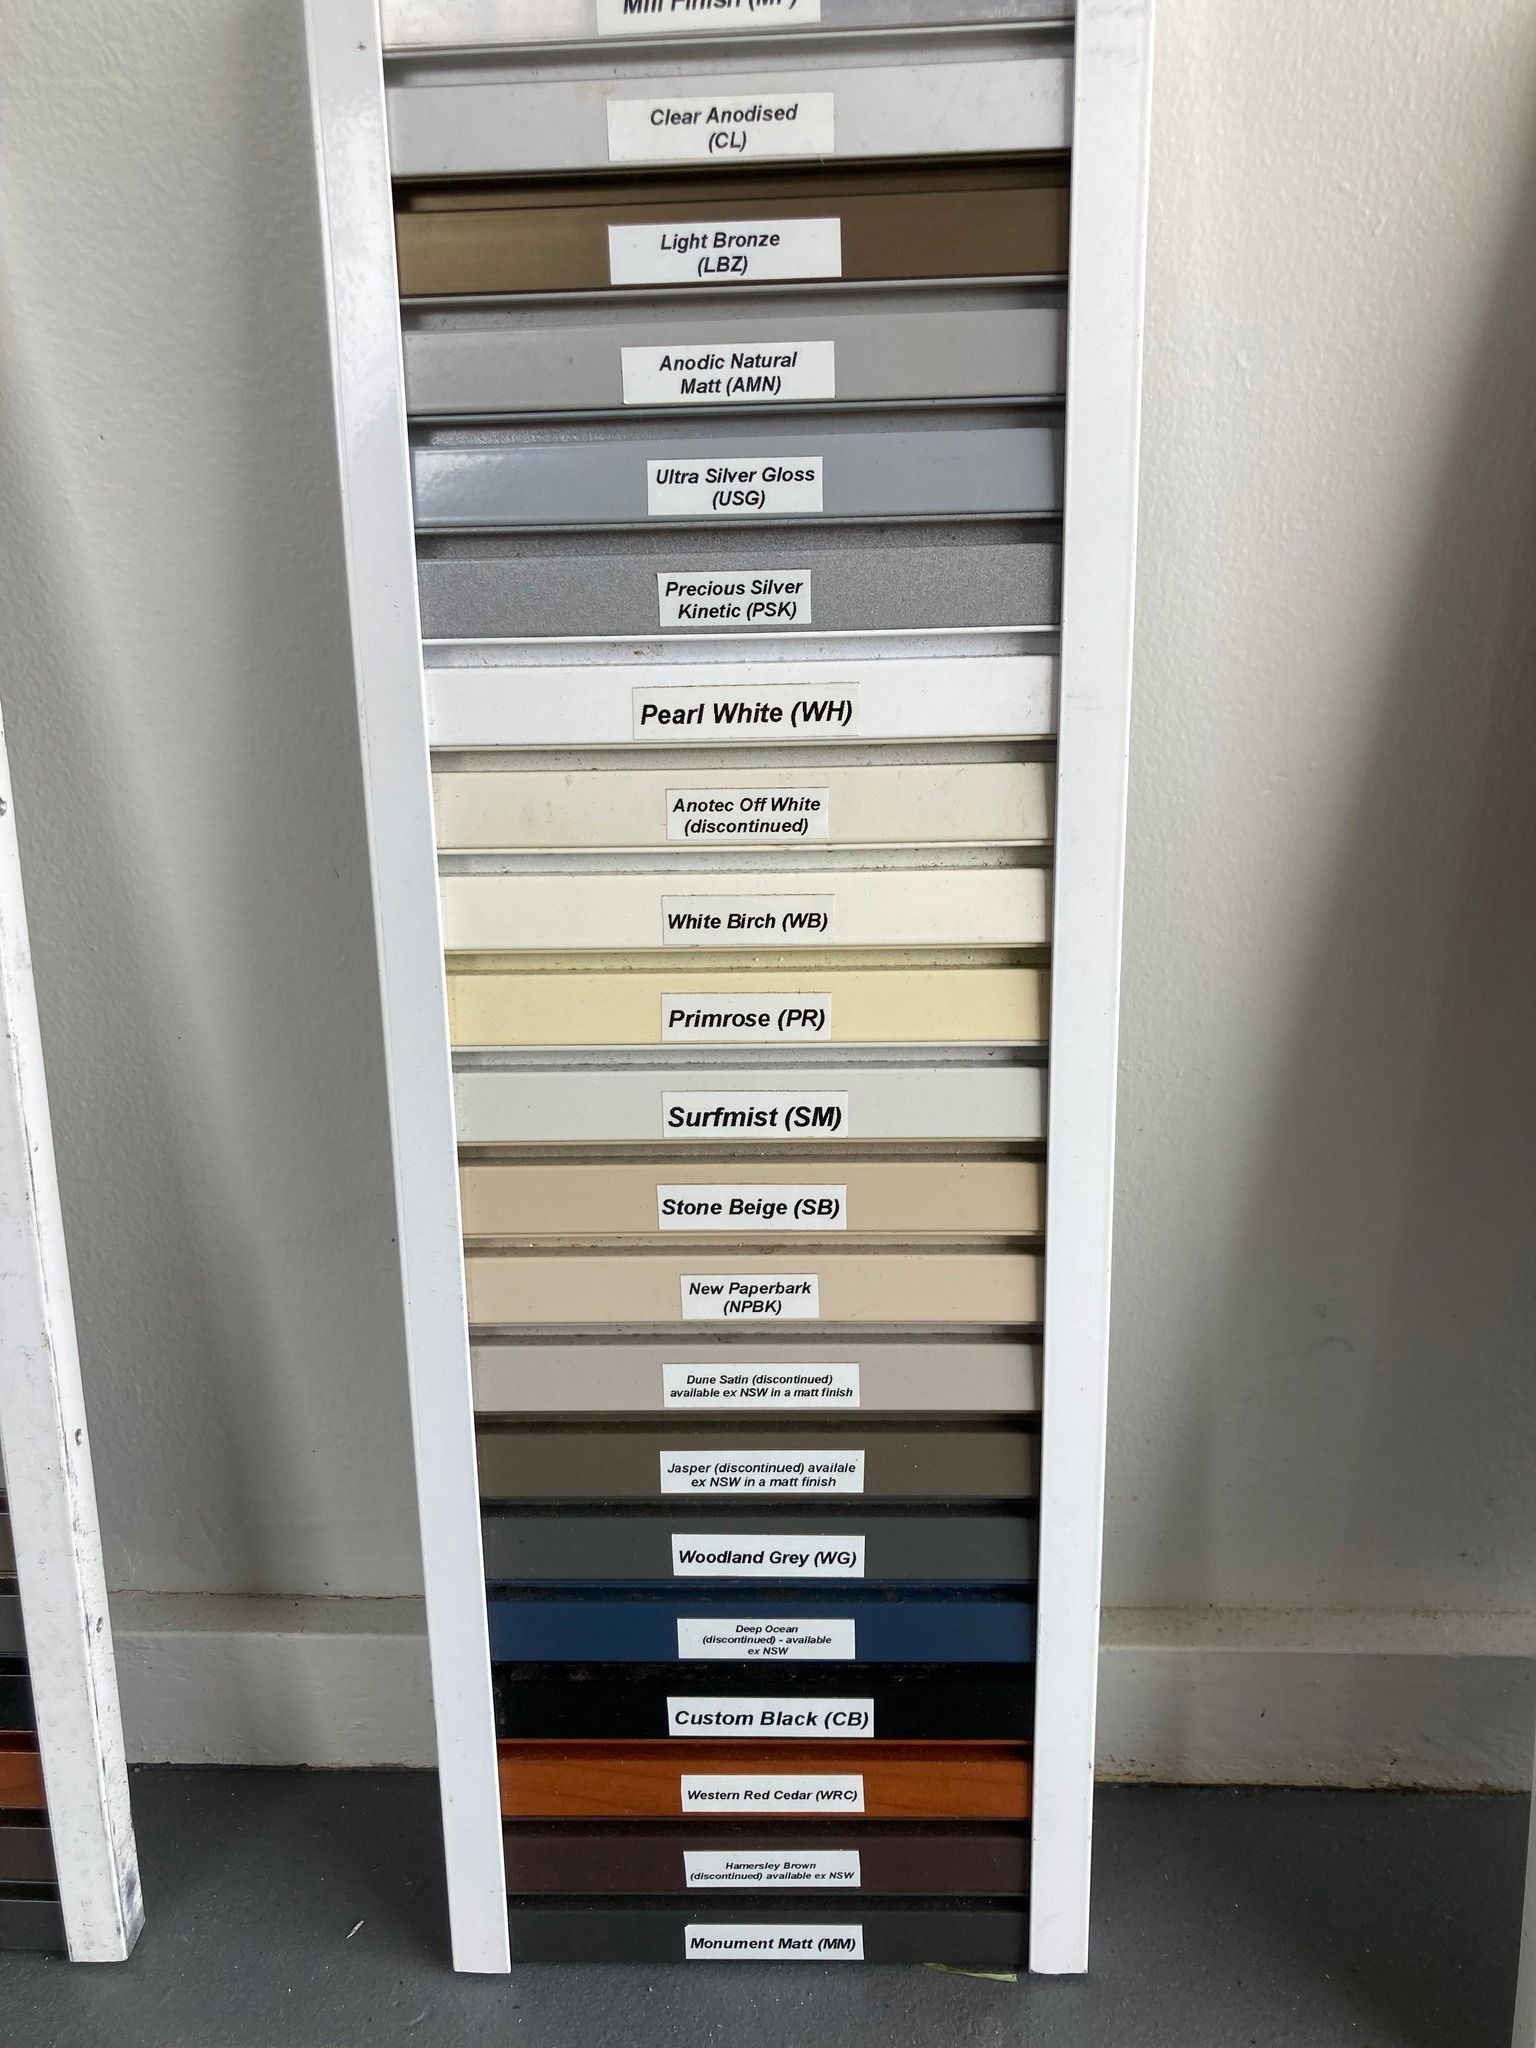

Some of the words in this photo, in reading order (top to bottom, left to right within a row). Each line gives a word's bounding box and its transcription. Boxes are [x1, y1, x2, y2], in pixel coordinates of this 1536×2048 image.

[623, 0, 663, 14] Mill
[650, 108, 702, 126] Clear
[706, 103, 798, 124] Anodised
[708, 131, 747, 153] (CL)
[661, 233, 708, 254] Light
[713, 232, 780, 248] Bronze
[698, 255, 748, 277] (LBZ)
[659, 354, 725, 371] Anodic
[730, 351, 798, 369] Natural
[680, 378, 722, 394] Matt
[726, 376, 781, 397] (AMN)
[656, 469, 699, 484] Ultra
[705, 468, 757, 483] Silver
[762, 466, 815, 482] Gloss
[712, 490, 765, 510] (USG)
[665, 581, 745, 597] Precious
[750, 579, 804, 595] Silver
[678, 603, 741, 619] Kinetic
[746, 601, 797, 621] (PSK)
[641, 703, 705, 725] Pearl
[713, 702, 783, 724] White
[791, 700, 852, 728] (WH)
[672, 798, 734, 812] Anotec
[740, 797, 768, 812] Off
[771, 797, 820, 811] White
[684, 818, 808, 837] (discontinued)
[668, 914, 721, 929] White
[727, 913, 776, 929] Birch
[782, 913, 828, 932] (WB)
[668, 1010, 770, 1028] Primrose
[778, 1009, 825, 1031] (PR)
[668, 1106, 778, 1128] Surfmist
[785, 1106, 842, 1132] (SM)
[662, 1199, 722, 1215] Stone
[729, 1198, 787, 1219] Beige
[794, 1199, 840, 1220] (SB)
[689, 1282, 724, 1295] New
[728, 1281, 811, 1298] Paperbark
[723, 1300, 782, 1316] (NPBK)
[687, 1375, 716, 1384] Dune
[719, 1375, 749, 1384] Satin
[752, 1374, 833, 1386] (discontinued)
[670, 1388, 720, 1397] available
[740, 1388, 769, 1397] NSW
[770, 1388, 781, 1397] in
[793, 1388, 819, 1397] matt
[821, 1387, 853, 1397] finish
[667, 1463, 712, 1476] Jasper
[714, 1463, 804, 1475] (discontinued)
[808, 1462, 856, 1473] availale
[691, 1479, 707, 1487] ex
[709, 1477, 742, 1487] NSW
[744, 1477, 755, 1487] in
[758, 1479, 766, 1487] a
[770, 1477, 799, 1487] matt
[802, 1476, 836, 1487] finish
[679, 1550, 765, 1564] Woodland
[769, 1551, 810, 1568] Grey
[814, 1551, 857, 1568] (WG)
[736, 1625, 762, 1635] Deep
[765, 1625, 798, 1633] Ocean
[702, 1635, 776, 1645] (discontinued)
[785, 1636, 832, 1644] available
[763, 1647, 789, 1655] NSW
[675, 1710, 753, 1725] Custom
[760, 1711, 818, 1726] Black
[824, 1712, 869, 1730] (CB)
[688, 1790, 740, 1800] Western
[743, 1790, 770, 1800] Red
[774, 1790, 813, 1800] Cedar
[816, 1790, 857, 1802] (WRC)
[725, 1862, 781, 1871] Hamersley
[690, 1872, 763, 1881] (discontinued)
[690, 1938, 774, 1949] Monument
[778, 1938, 813, 1949] Matt
[818, 1938, 856, 1952] (MM)
